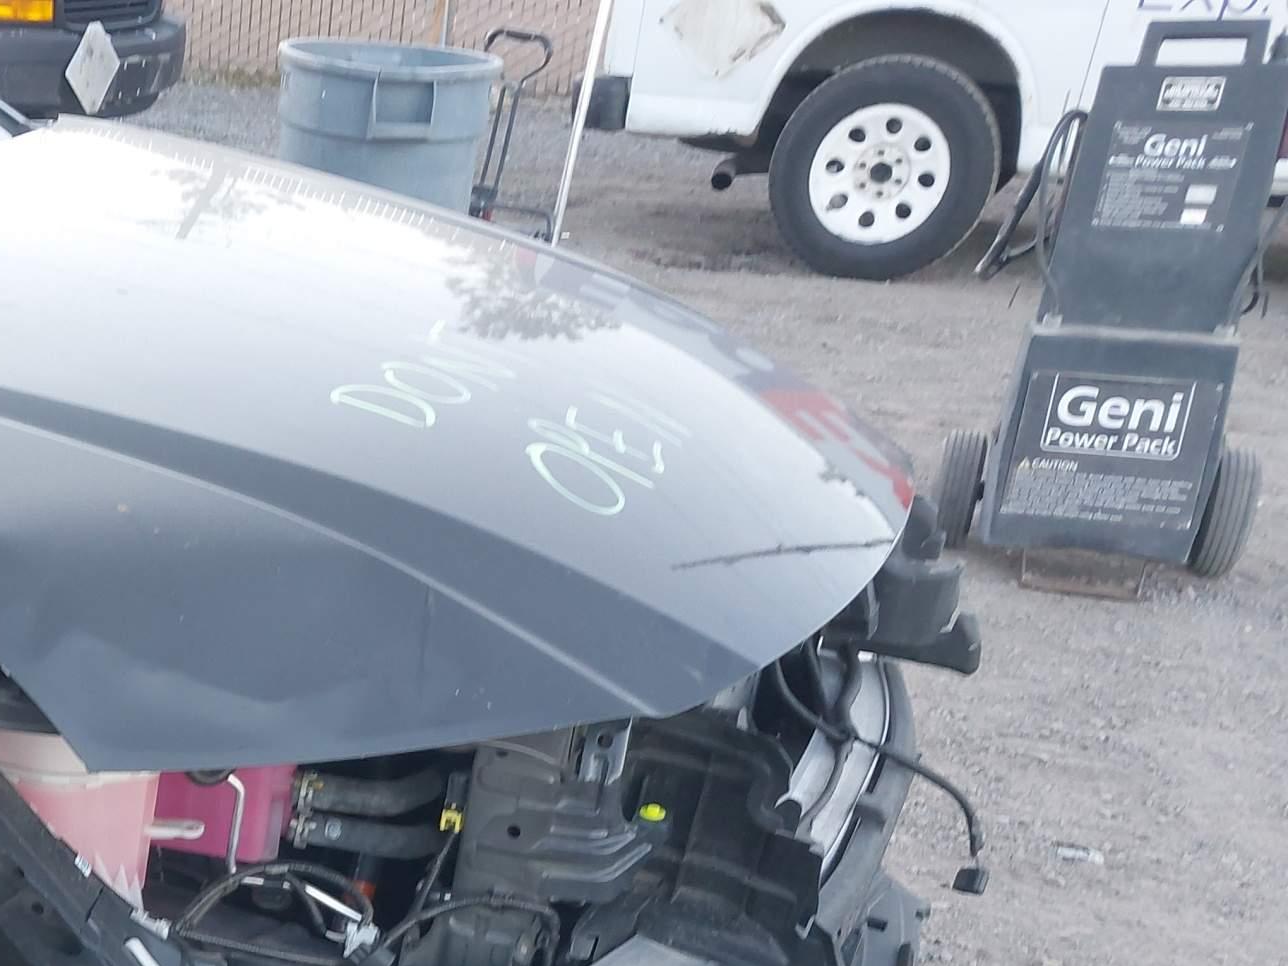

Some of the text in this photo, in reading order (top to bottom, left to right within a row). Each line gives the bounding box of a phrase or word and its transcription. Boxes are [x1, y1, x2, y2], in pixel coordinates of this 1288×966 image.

[1057, 385, 1184, 433] Geni
[1045, 427, 1178, 457] Power Pack
[1031, 456, 1079, 473] CAUTION
